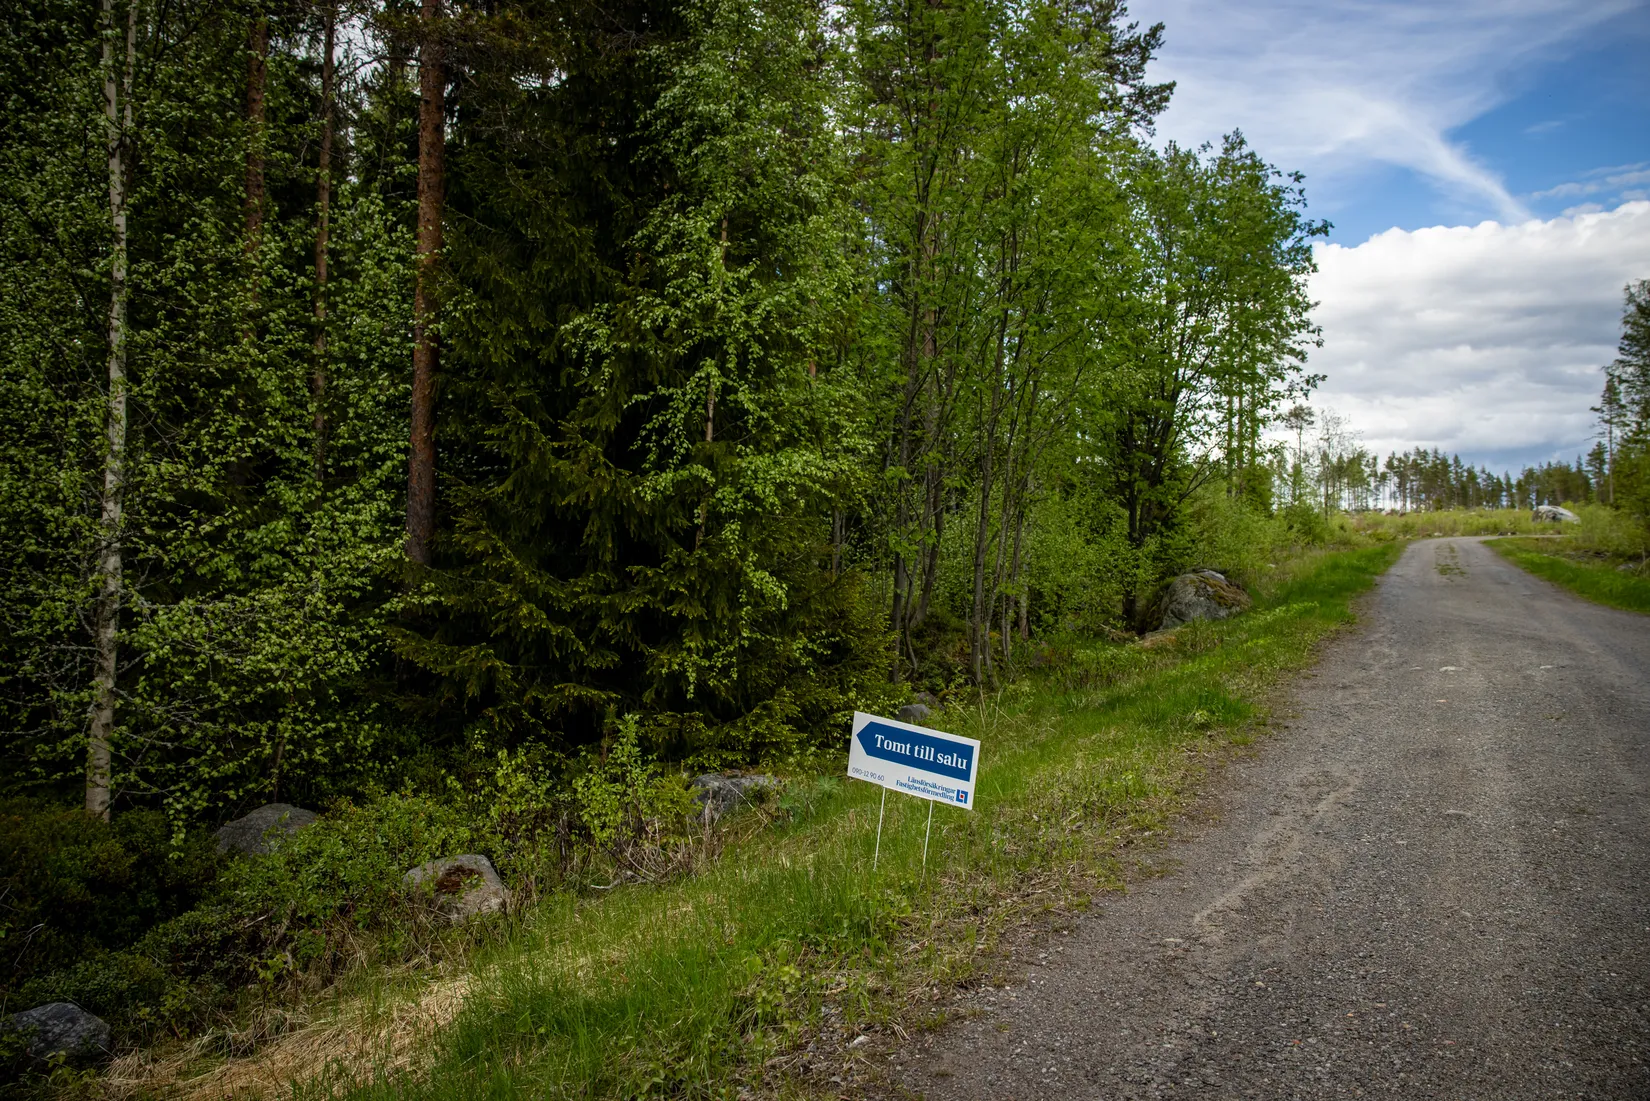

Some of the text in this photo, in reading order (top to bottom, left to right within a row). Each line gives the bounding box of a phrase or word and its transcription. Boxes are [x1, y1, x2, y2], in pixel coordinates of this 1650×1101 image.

[875, 734, 968, 770] Tomt till salu
[870, 771, 877, 780] 90
[877, 774, 884, 782] 60
[907, 775, 956, 794] Länsförsäkringar
[896, 780, 955, 801] Fastighetsförmedling
